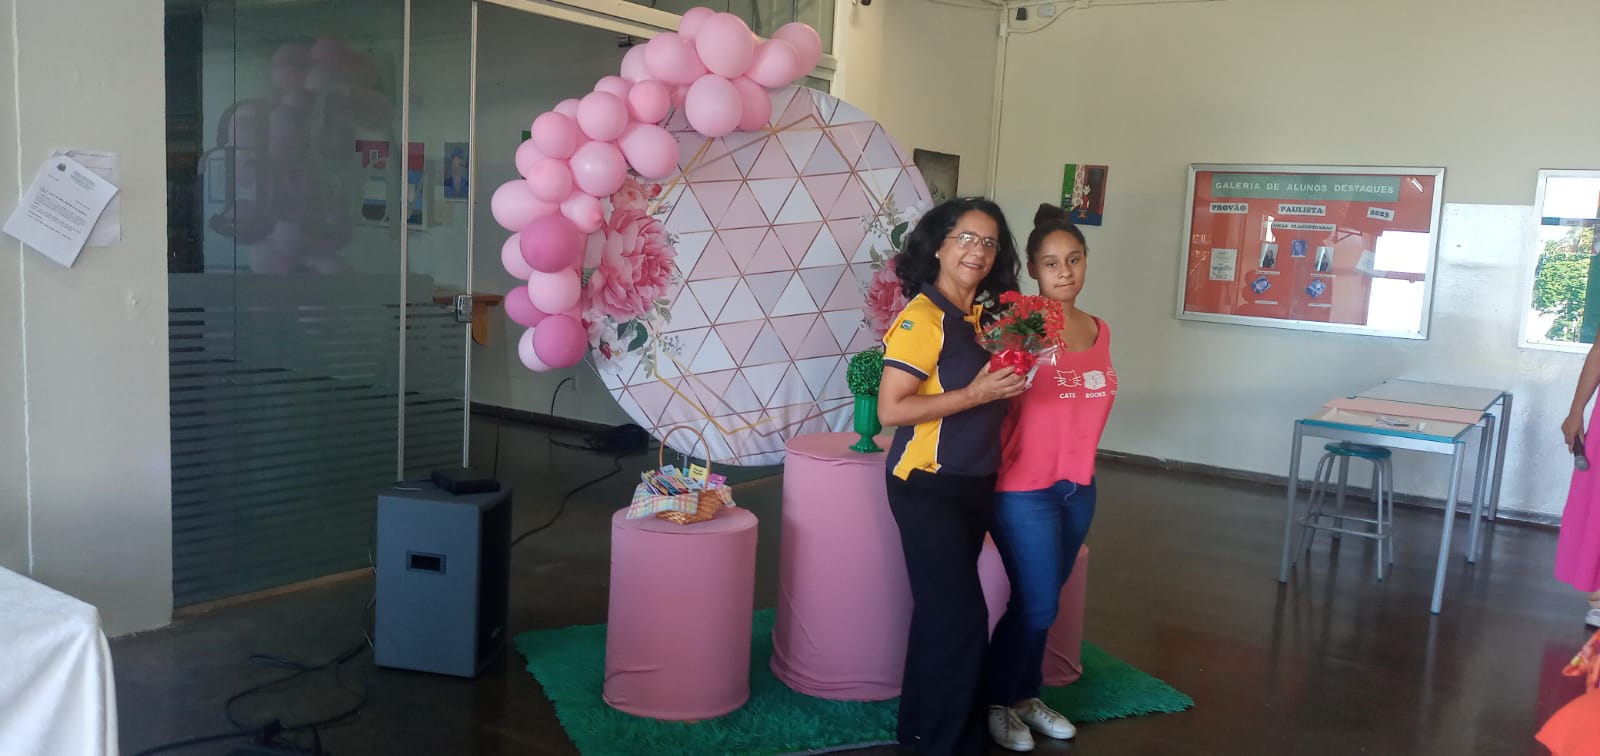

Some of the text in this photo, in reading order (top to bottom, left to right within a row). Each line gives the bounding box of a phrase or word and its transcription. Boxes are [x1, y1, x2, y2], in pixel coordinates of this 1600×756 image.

[1215, 181, 1394, 194] GALERIA DE ALUNOS DESTAQUES
[1211, 202, 1247, 212] PROVÃO
[1280, 205, 1323, 214] PAULISTA
[1085, 391, 1107, 399] BOOKS
